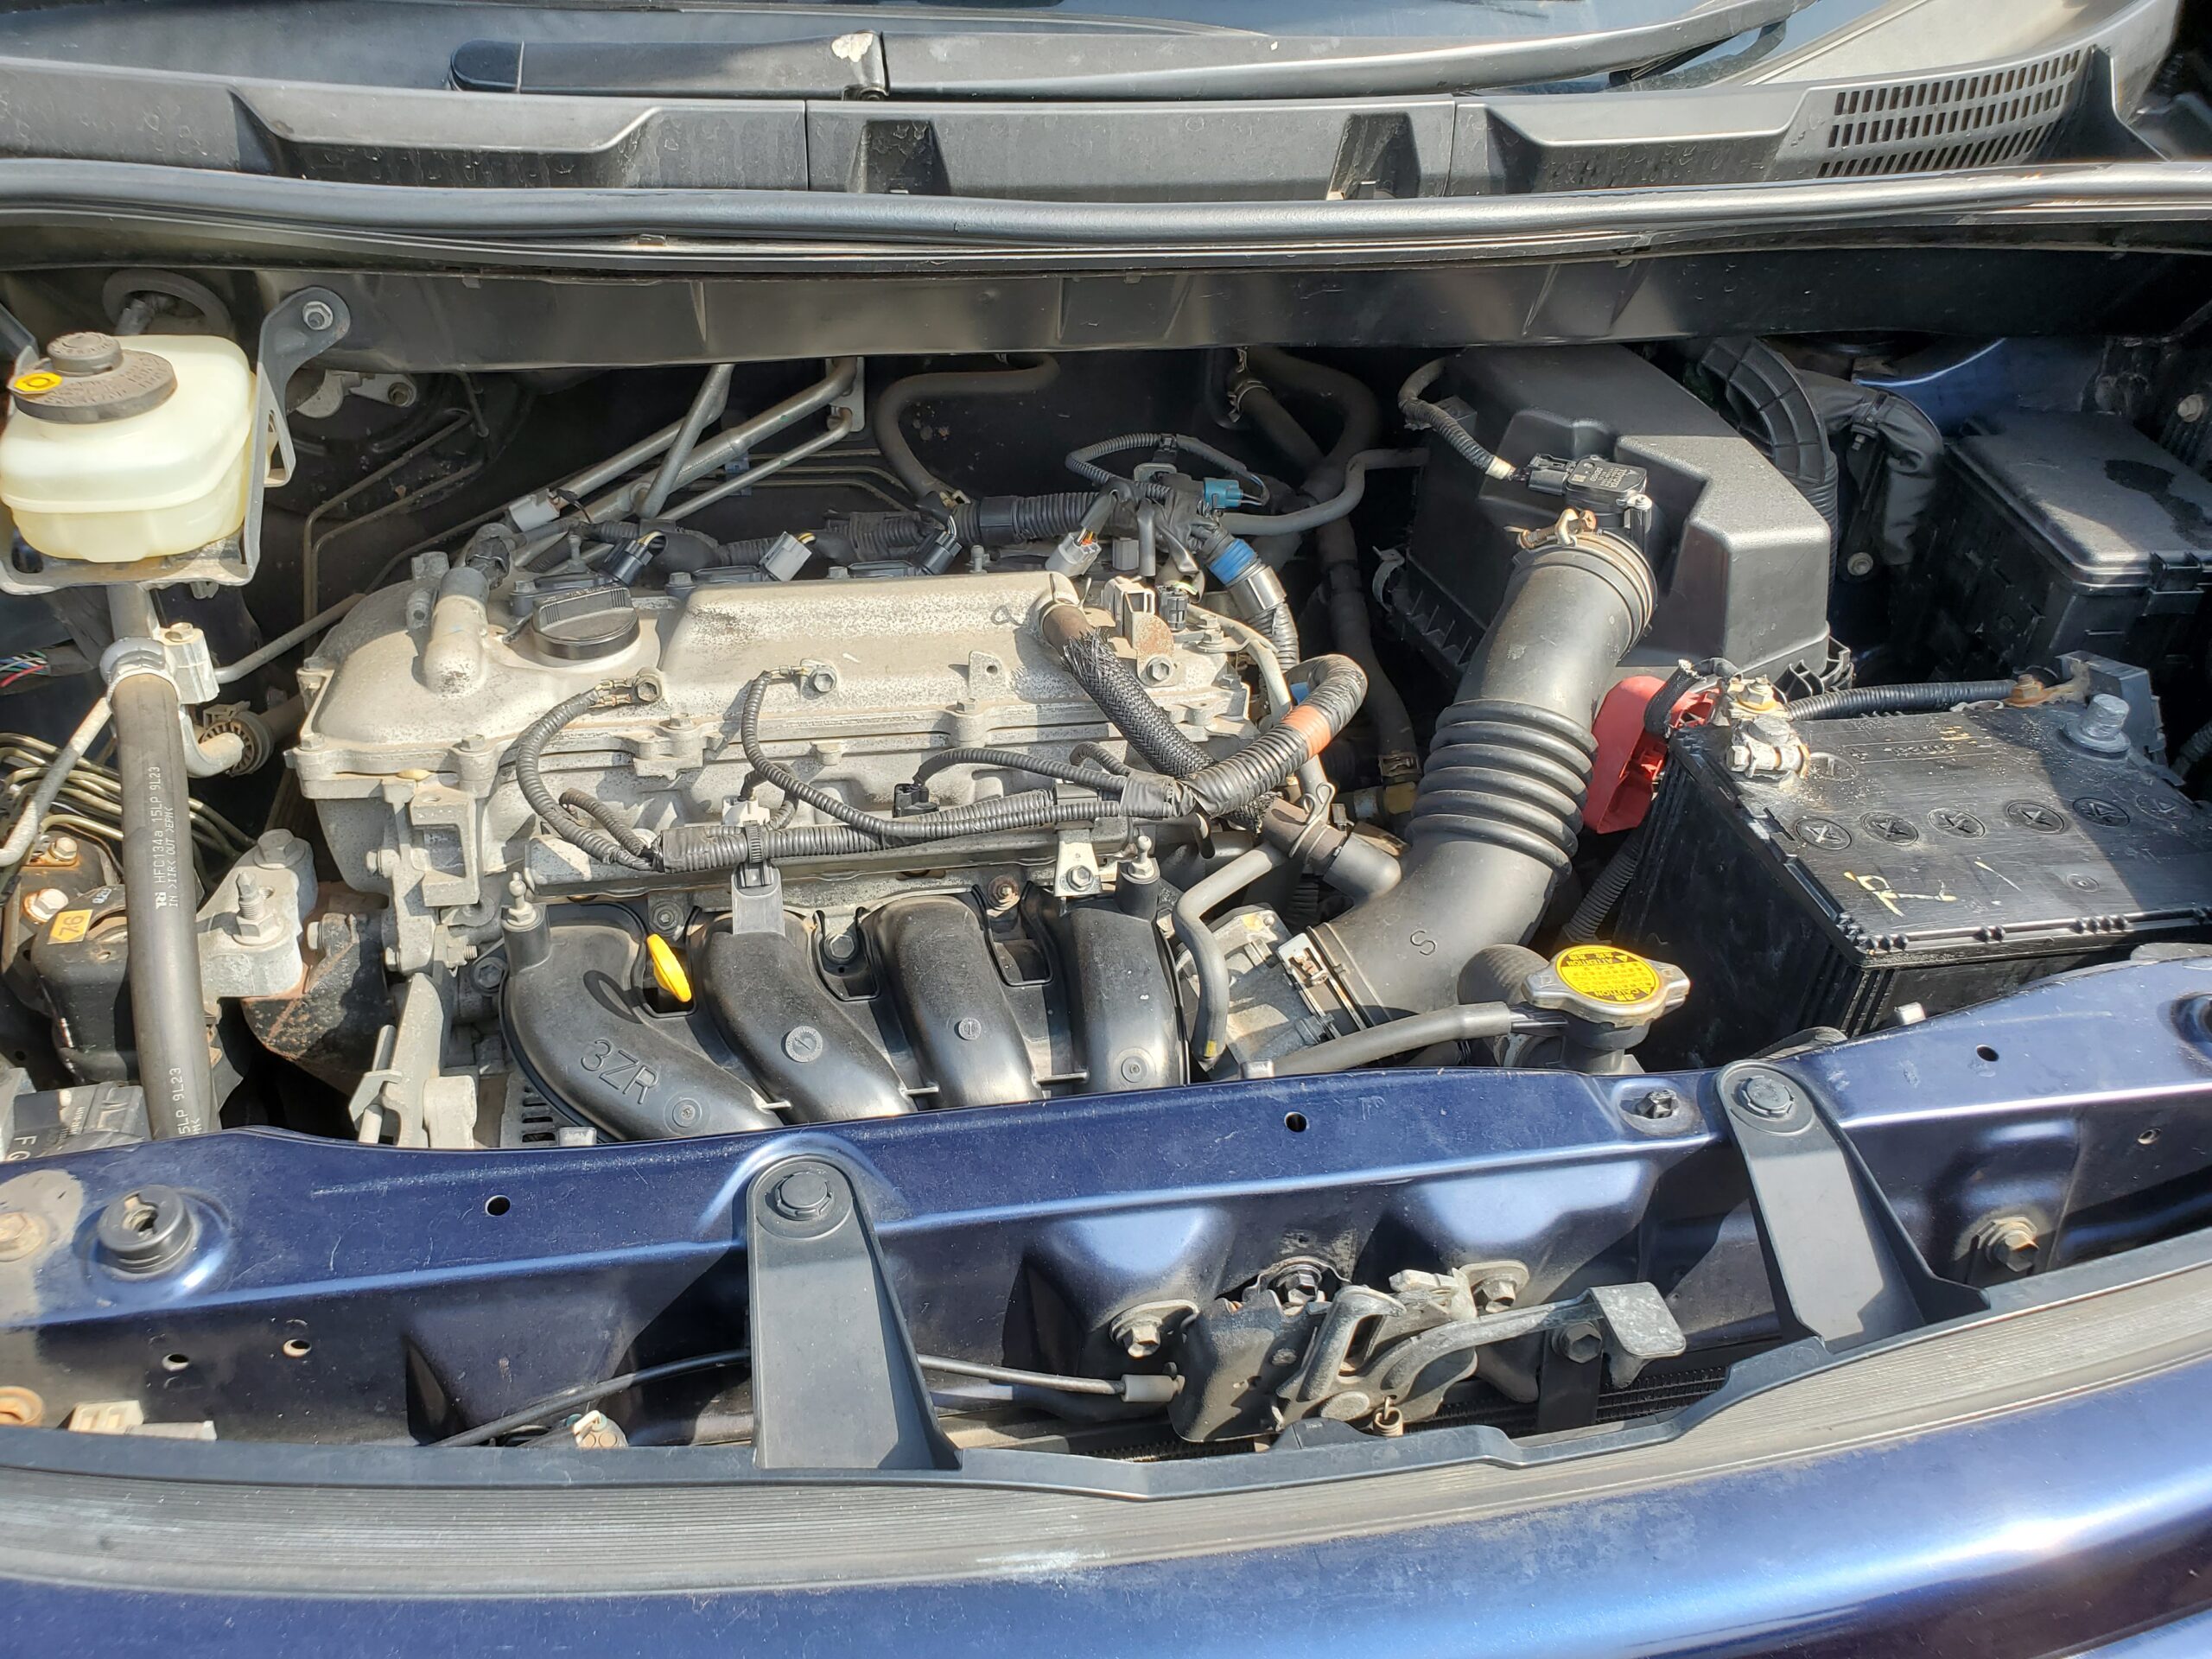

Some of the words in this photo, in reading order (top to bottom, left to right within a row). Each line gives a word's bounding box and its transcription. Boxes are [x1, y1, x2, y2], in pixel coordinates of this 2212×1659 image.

[148, 766, 162, 791] 9L23
[149, 796, 163, 823] 15LP
[152, 830, 166, 883] HFC134a
[165, 838, 175, 855] OUT
[168, 895, 179, 907] IN
[1409, 929, 1437, 956] S
[1567, 957, 1613, 967] ATTENTION
[1594, 988, 1640, 996] CAUTION
[169, 1067, 185, 1102] 9L23
[580, 1039, 659, 1105] 3ZR
